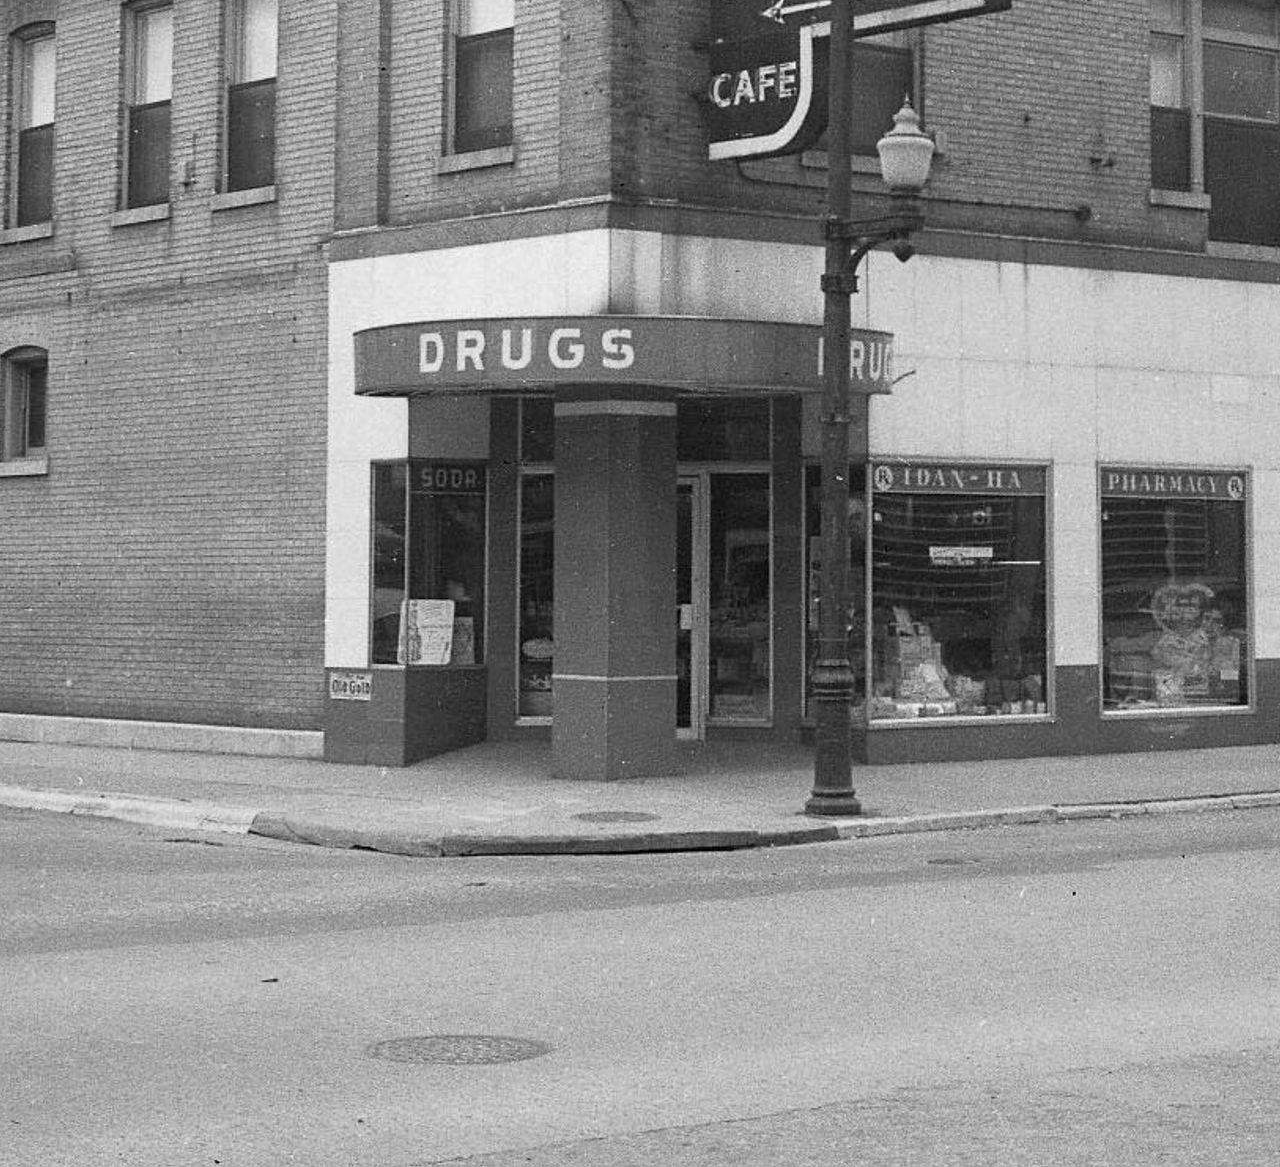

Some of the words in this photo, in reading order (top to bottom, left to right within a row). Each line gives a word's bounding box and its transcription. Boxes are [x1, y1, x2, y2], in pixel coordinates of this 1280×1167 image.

[710, 61, 799, 109] CAFE
[418, 327, 636, 372] DRUGS
[421, 468, 477, 488] SODA
[903, 468, 1023, 489] IDAN-HA
[1107, 473, 1218, 494] PHARMACY
